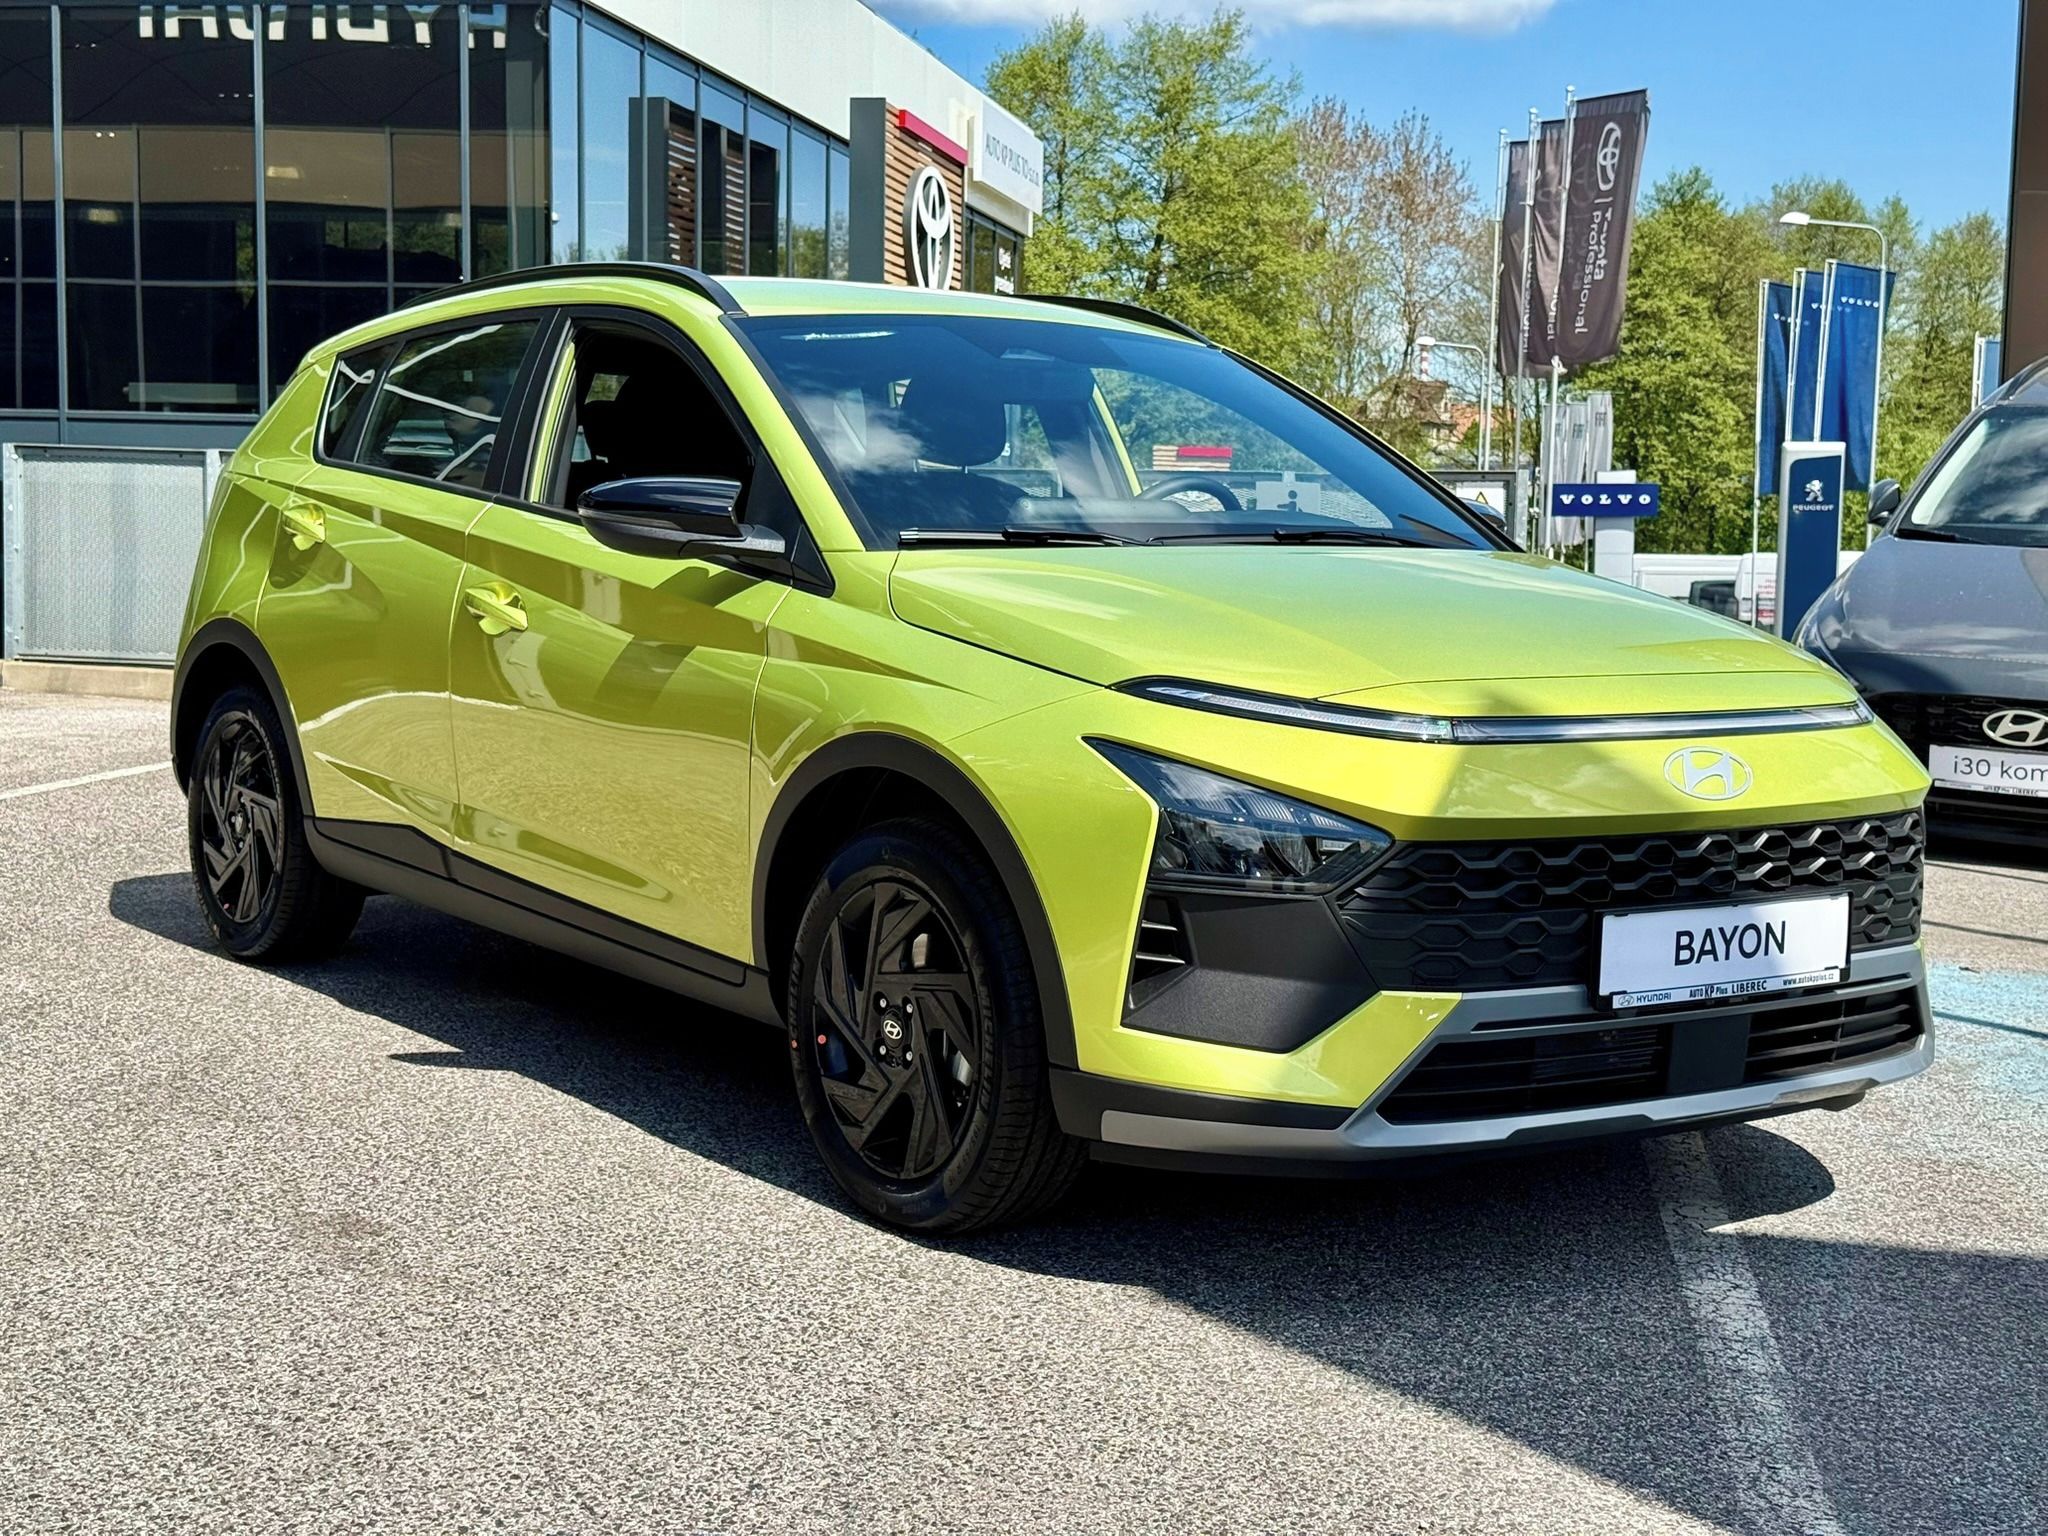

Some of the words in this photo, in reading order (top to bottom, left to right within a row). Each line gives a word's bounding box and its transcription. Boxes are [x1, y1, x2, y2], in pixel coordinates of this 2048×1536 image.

[1559, 493, 1652, 505] VOLVO
[1792, 503, 1835, 513] PEUGEOT
[1953, 755, 1991, 777] i30
[1674, 920, 1786, 966] BAYON
[1636, 992, 1672, 1003] HYUNDAI
[1689, 988, 1703, 998] AUTO
[1704, 984, 1715, 998] KP
[1715, 986, 1728, 995] Plus
[1731, 980, 1767, 994] LIBEREC
[1782, 973, 1834, 986] www.autokpplus.cz
